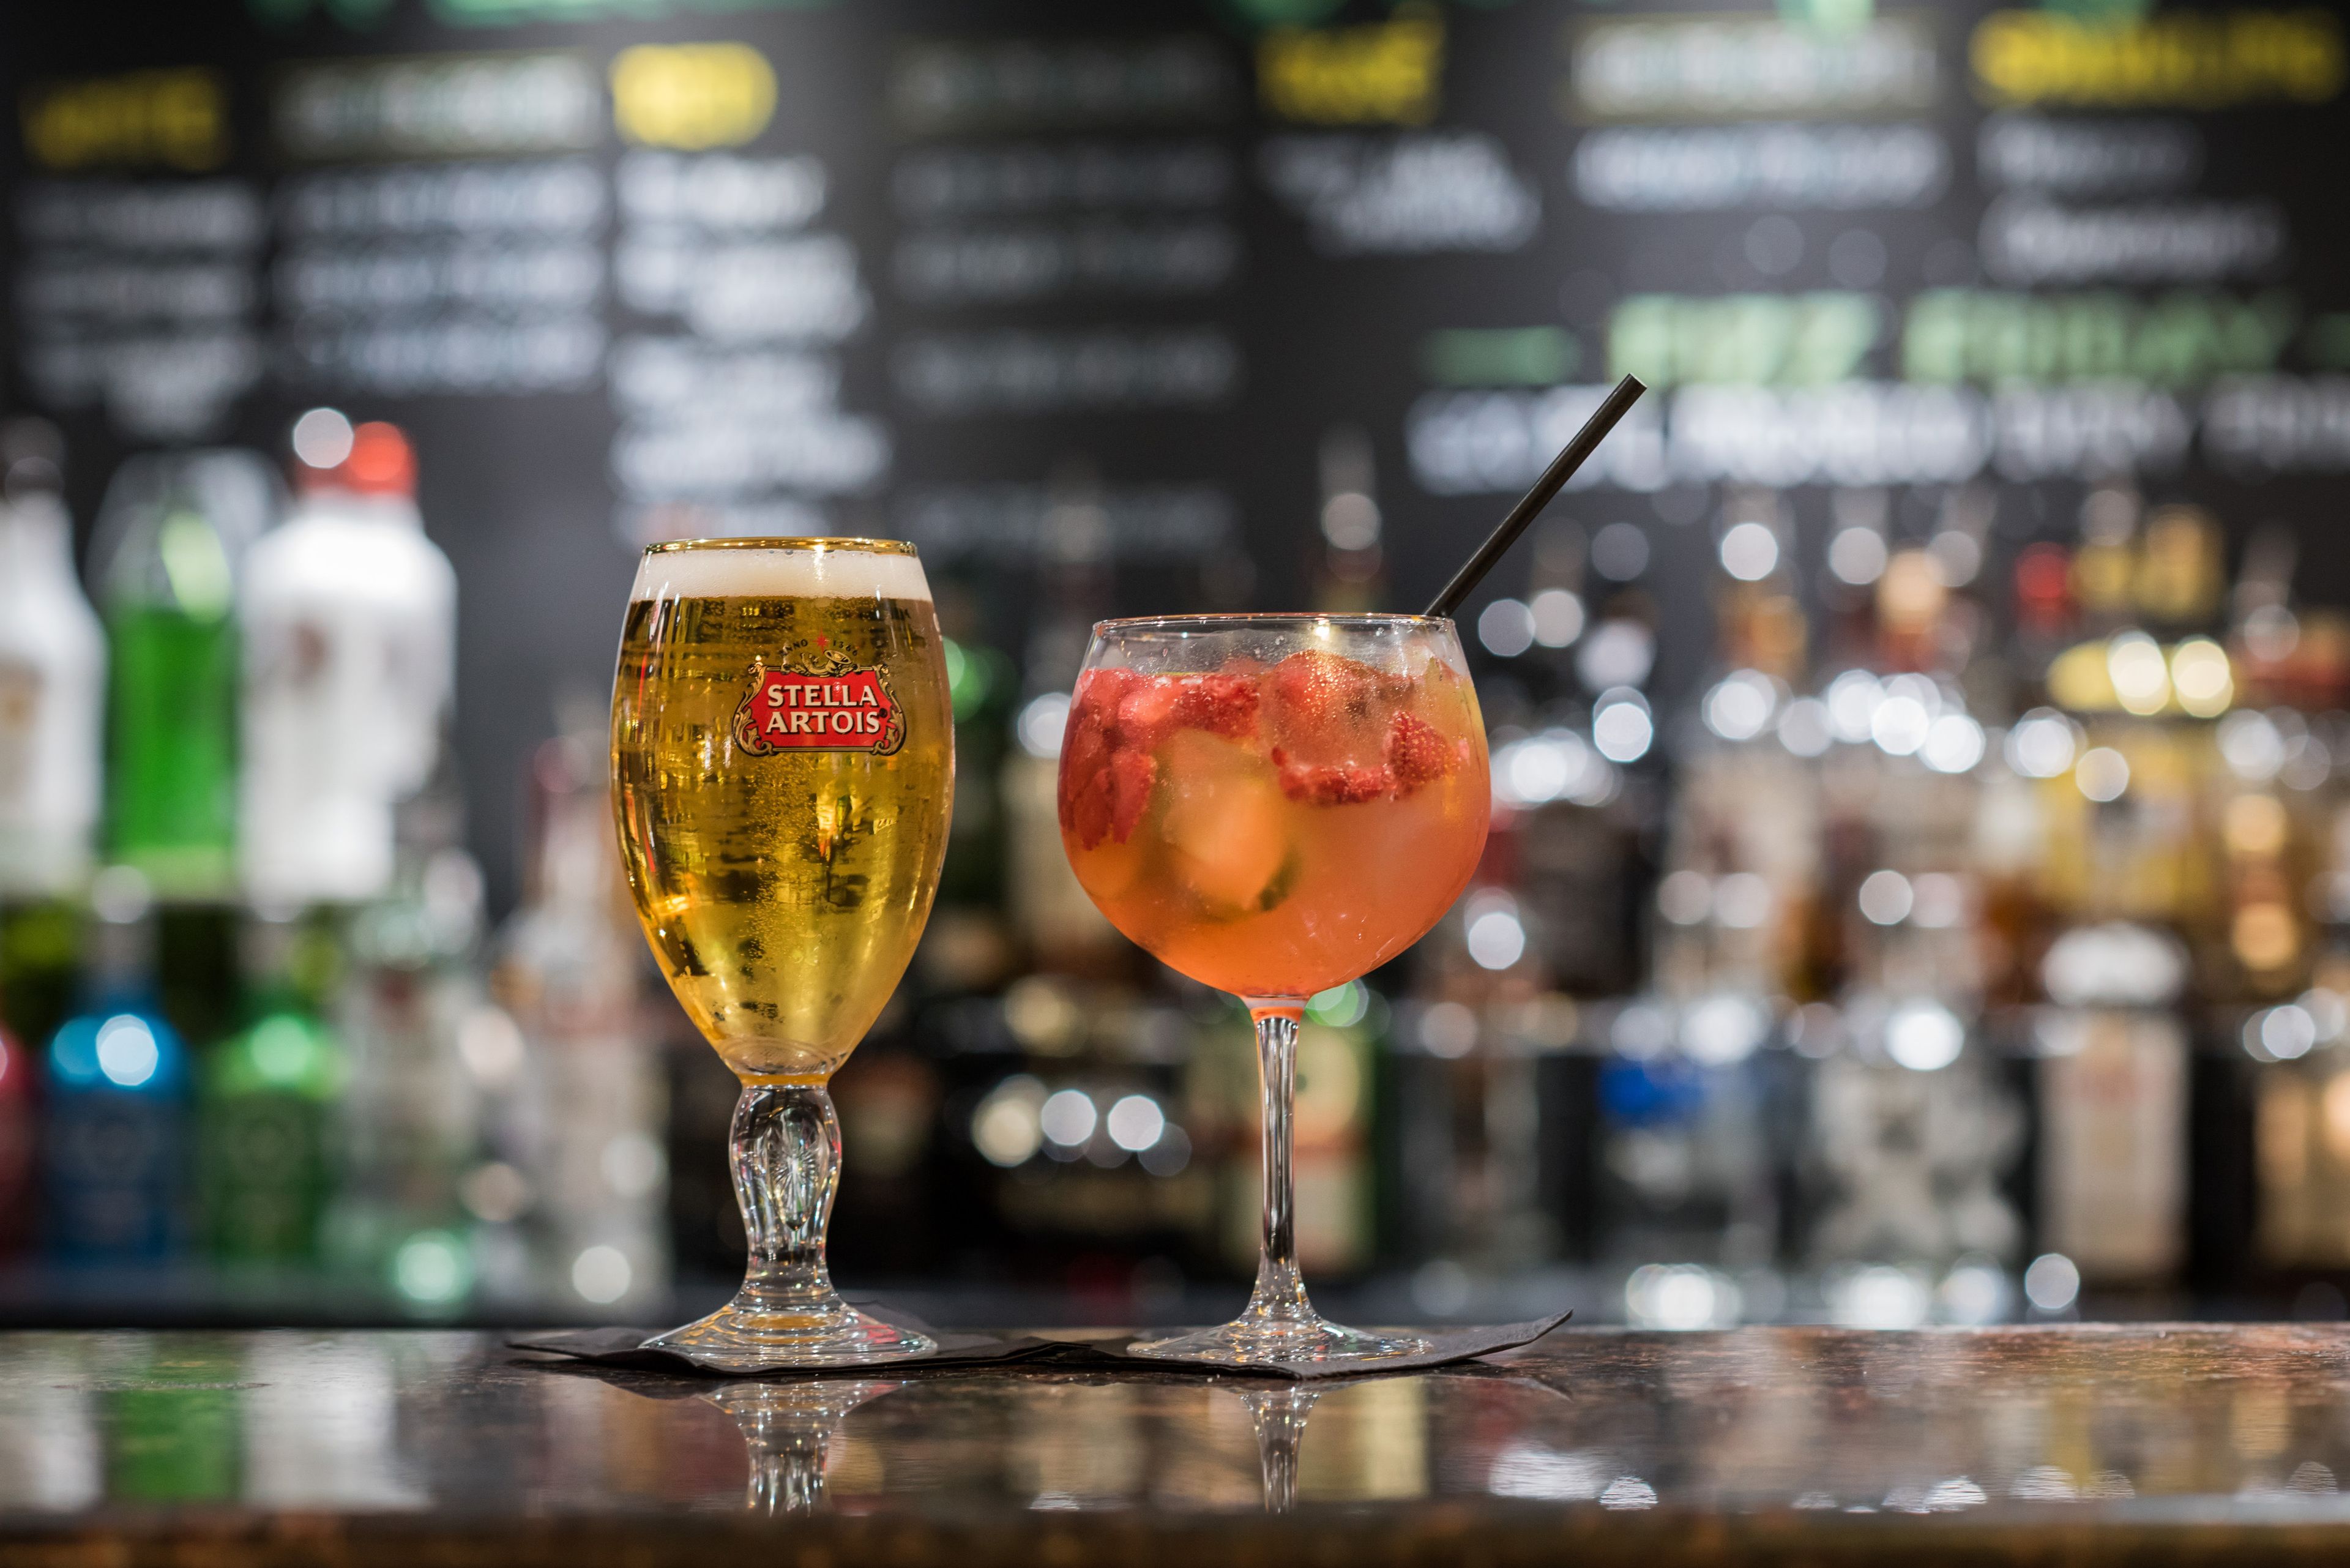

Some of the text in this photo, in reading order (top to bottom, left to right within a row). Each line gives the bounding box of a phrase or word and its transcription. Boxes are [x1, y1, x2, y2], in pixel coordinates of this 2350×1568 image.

[833, 640, 858, 657] 1366
[767, 684, 879, 707] STELLA
[765, 711, 881, 734] ARTOIS
